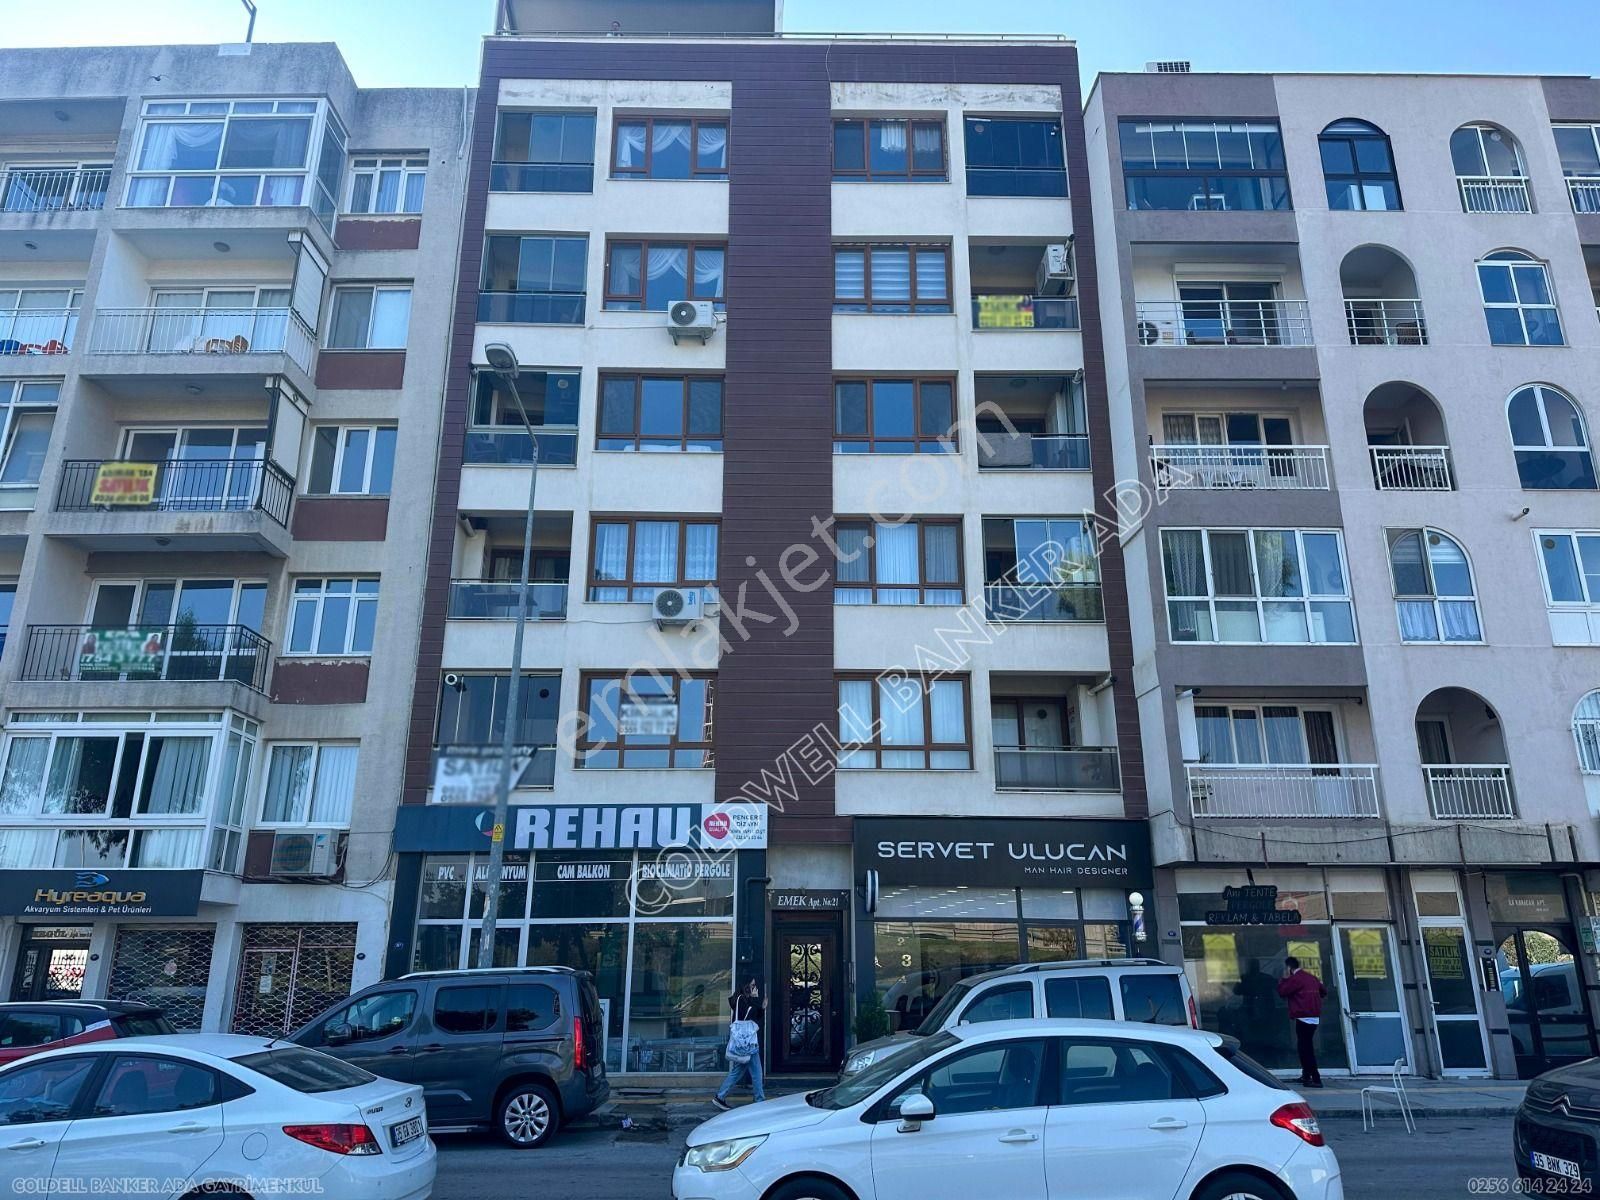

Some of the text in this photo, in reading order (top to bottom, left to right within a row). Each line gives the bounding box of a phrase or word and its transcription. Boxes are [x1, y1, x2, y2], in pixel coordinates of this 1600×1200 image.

[514, 807, 691, 849] REHAU
[877, 841, 1127, 861] SERVET ULUCAN
[438, 866, 455, 880] PVC
[475, 864, 527, 880] ALNYUM
[557, 864, 611, 879] CAM BALKON
[694, 863, 731, 877] PERGOLE
[1077, 868, 1128, 876] DESIGNER
[34, 888, 147, 904] Hyreaqua
[777, 895, 807, 906] EMEK
[24, 905, 61, 914] Akvaryum
[63, 905, 99, 913] Sistemleri
[108, 905, 120, 913] Pet
[122, 904, 152, 913] Ürünleri
[1534, 1153, 1544, 1168] 35
[1563, 1161, 1579, 1178] 329
